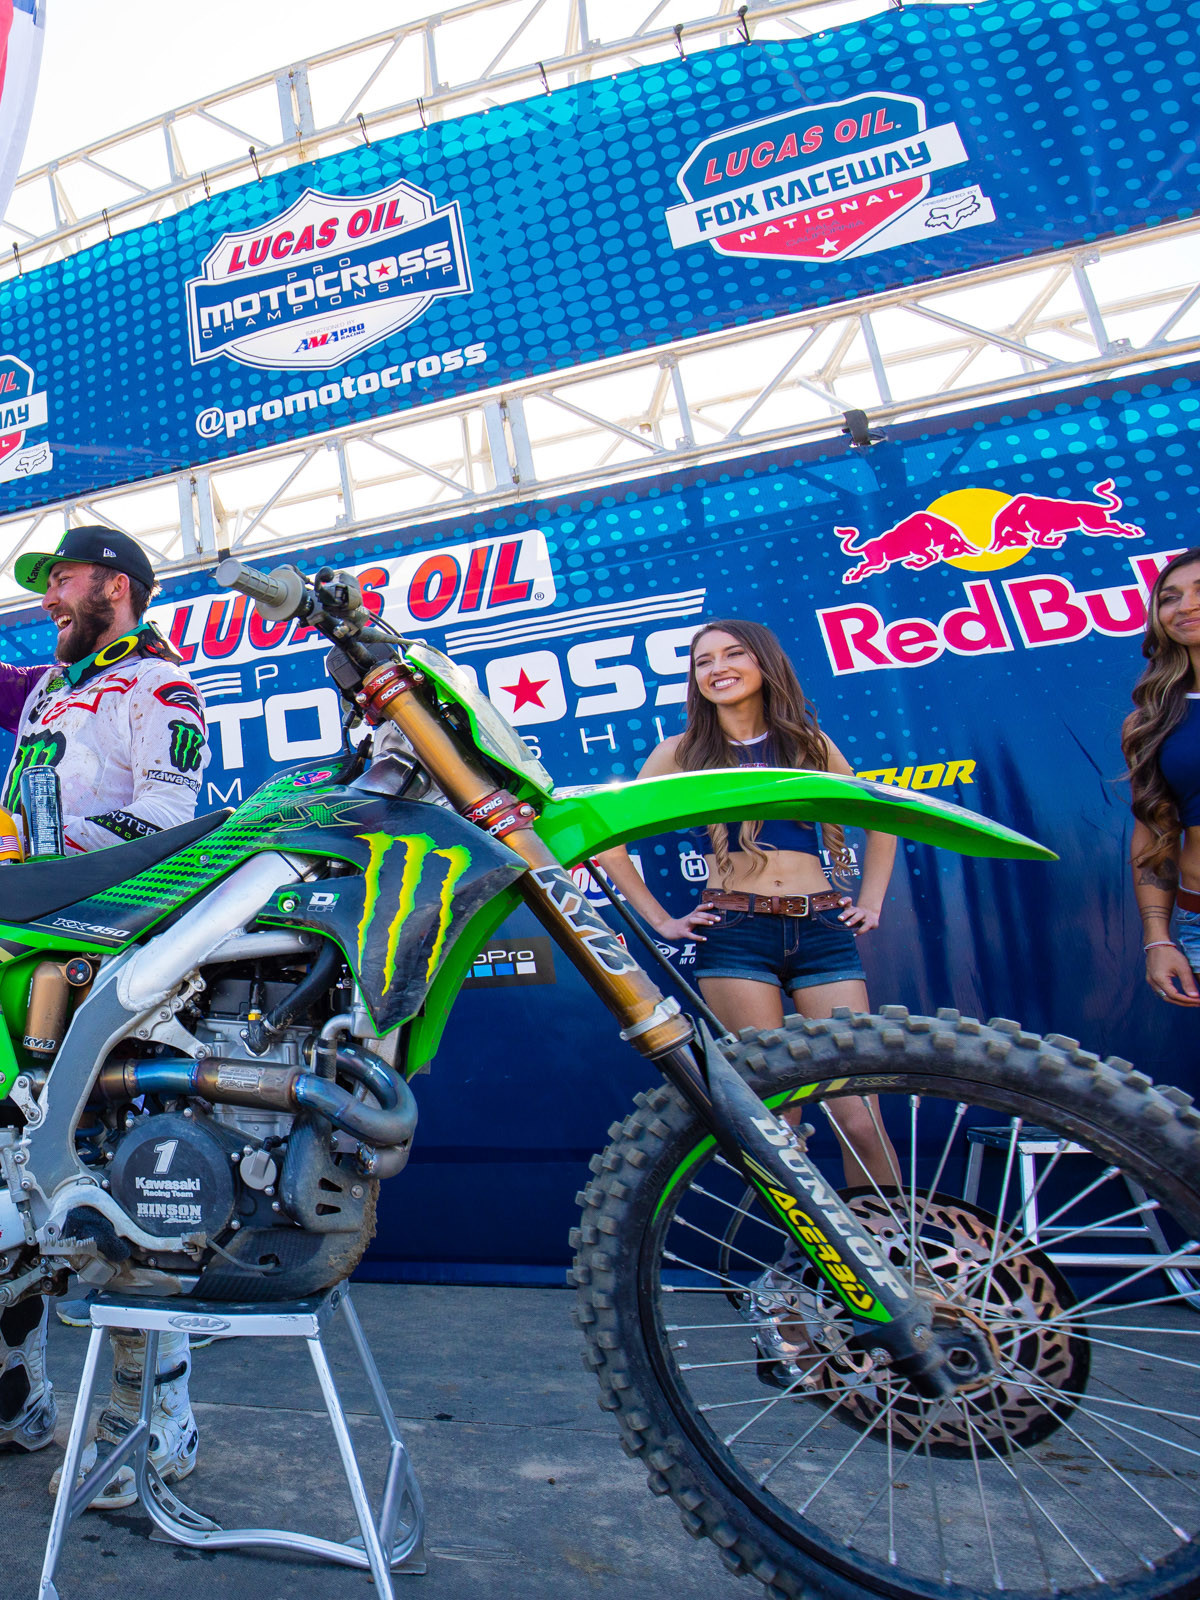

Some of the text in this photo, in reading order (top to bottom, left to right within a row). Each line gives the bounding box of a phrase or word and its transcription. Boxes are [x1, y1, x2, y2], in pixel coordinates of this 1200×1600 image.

[704, 125, 823, 185] LUCAS
[695, 140, 931, 232] FOX RACEWAY
[921, 189, 978, 208] PRESENTED BY
[739, 189, 903, 243] NATIONAL
[227, 217, 339, 274] LUCAS
[200, 241, 451, 329] MOTOCROSS
[287, 257, 350, 281] PRO
[202, 264, 454, 339] CHAMPIONSHIP
[293, 322, 365, 354] AMA PRO
[340, 330, 366, 341] RACING
[195, 342, 488, 438] @promotocross
[816, 579, 1014, 676] Red
[369, 670, 395, 690] XTRIG
[381, 681, 406, 701] ROCS
[855, 759, 977, 791] THOR
[466, 797, 503, 823] XTRIG
[486, 815, 516, 836] OCS
[52, 917, 131, 938] KX 450
[530, 865, 638, 976] KYB
[473, 949, 534, 964] oPro
[23, 1036, 55, 1049] KYB
[153, 1140, 179, 1174] 1
[135, 1177, 200, 1191] Kawasaki
[143, 1189, 193, 1198] Racing Team
[137, 1203, 202, 1216] HINSON
[750, 1116, 909, 1299] DUNLOP
[768, 1186, 874, 1310] ACERBIS
